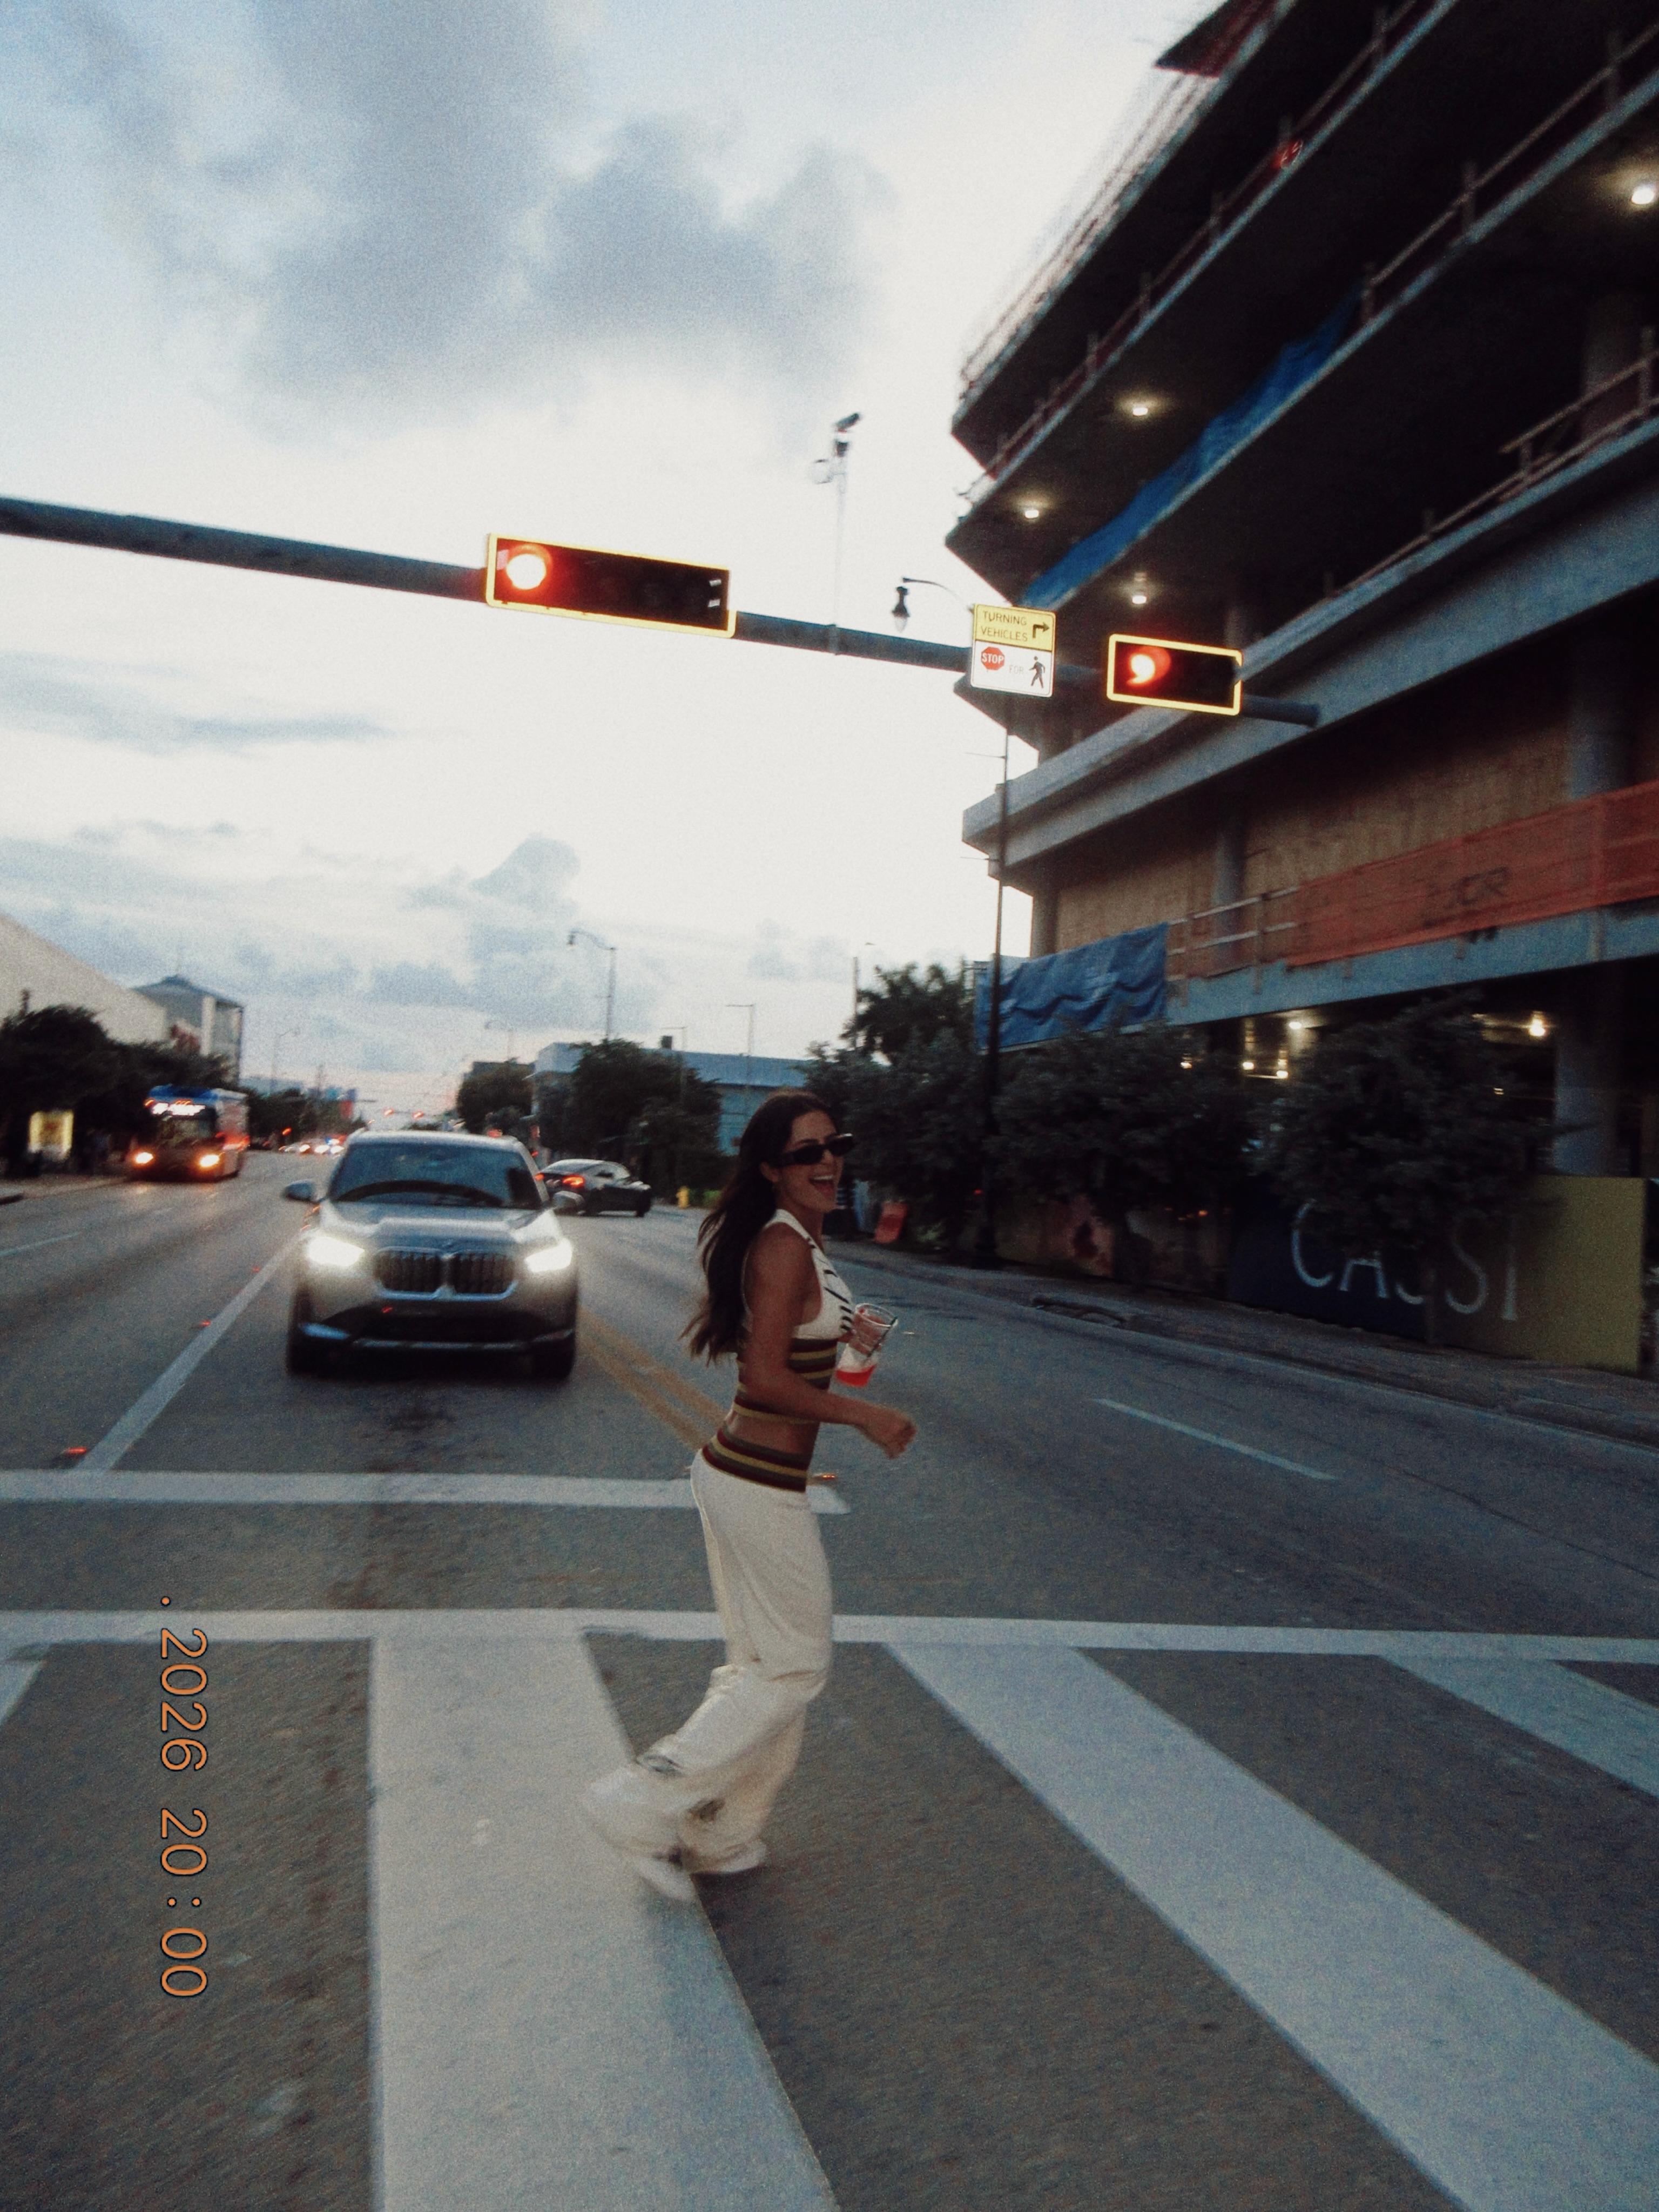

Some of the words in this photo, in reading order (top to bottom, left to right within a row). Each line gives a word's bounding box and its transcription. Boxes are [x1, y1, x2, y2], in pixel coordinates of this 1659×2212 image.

[983, 611, 1027, 626] TURNING
[981, 626, 1028, 642] VEHICLES
[981, 652, 1004, 664] STOP
[1009, 664, 1024, 675] FOR
